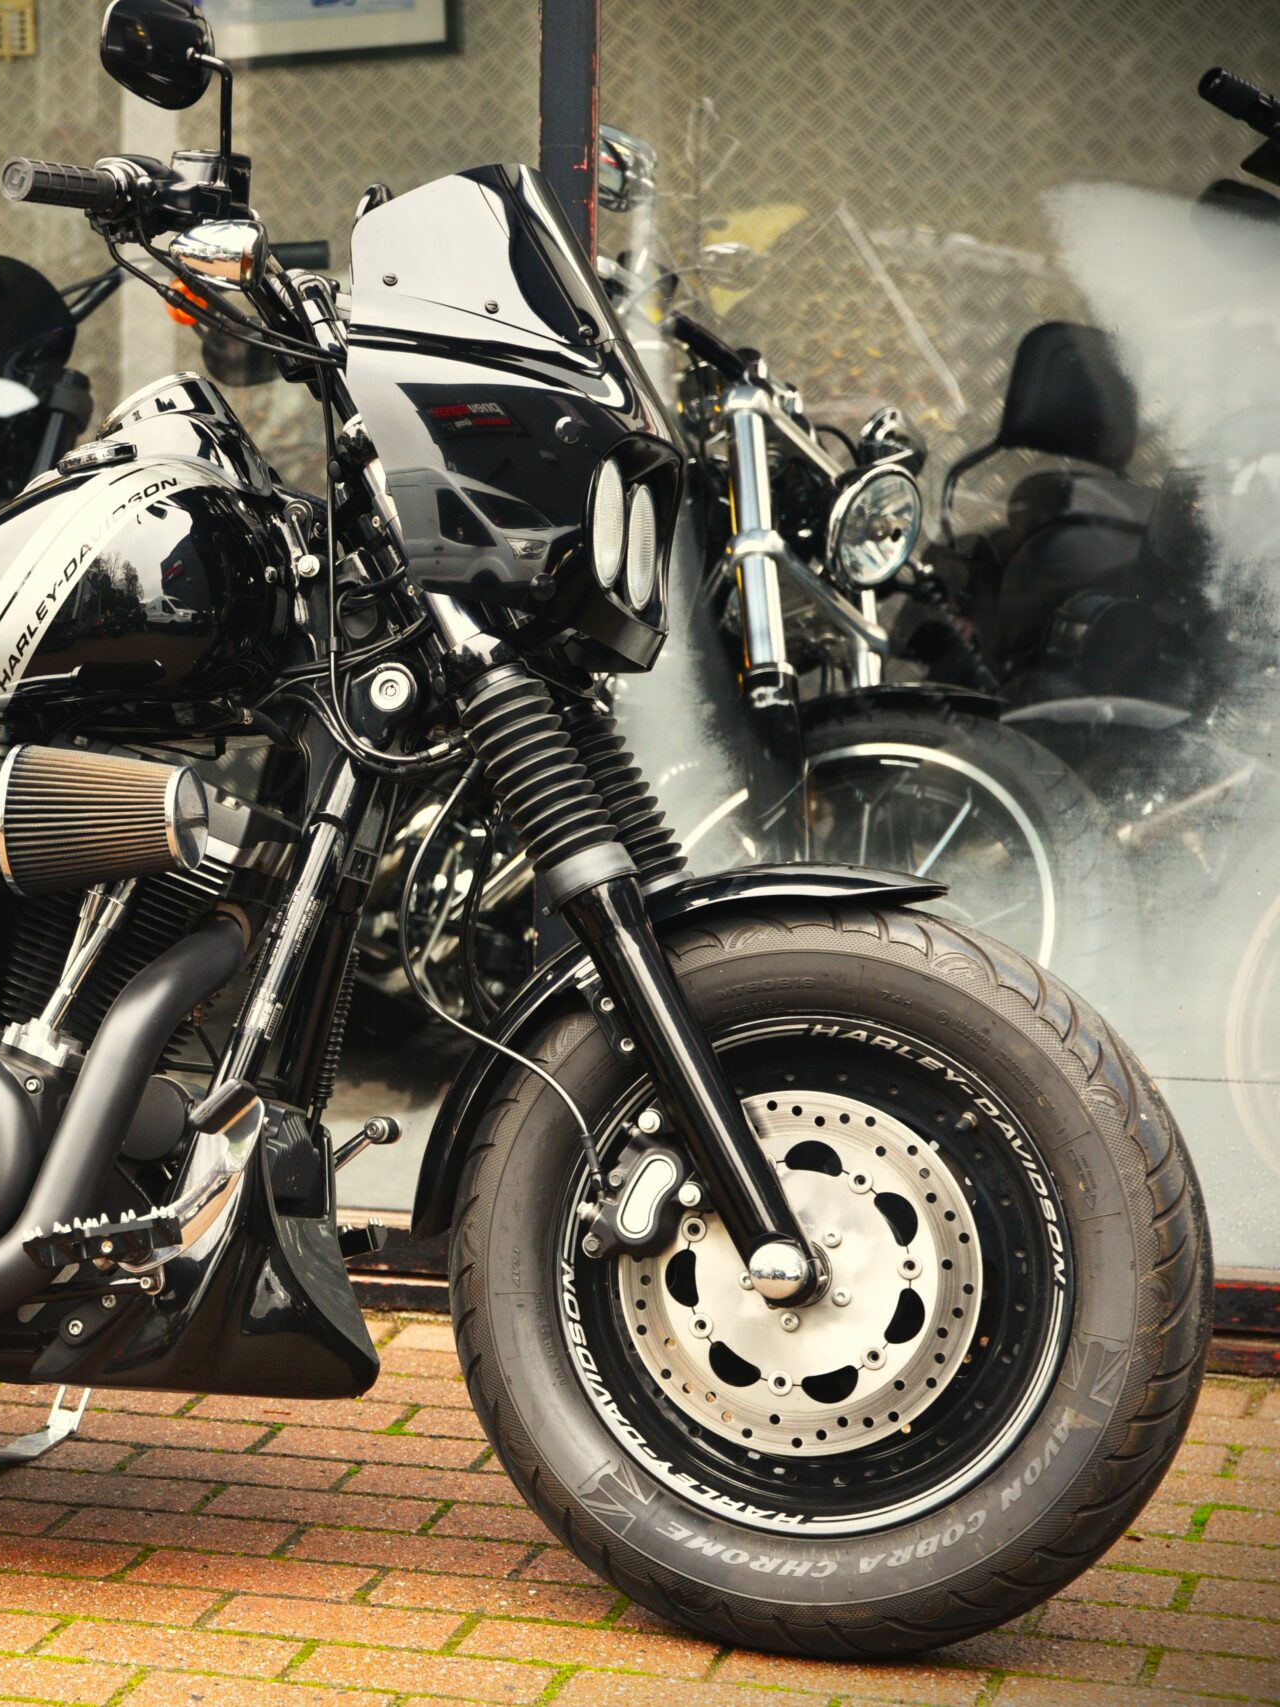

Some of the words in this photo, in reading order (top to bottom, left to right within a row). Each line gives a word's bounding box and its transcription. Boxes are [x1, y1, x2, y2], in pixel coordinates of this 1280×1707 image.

[810, 1024, 1066, 1285] HARLEY-DAVIDSON
[561, 1260, 819, 1528] HARLEY-DAVIDSON
[1001, 1406, 1072, 1512] AVON
[656, 1520, 838, 1578] CHROME
[859, 1511, 987, 1576] COBRA
